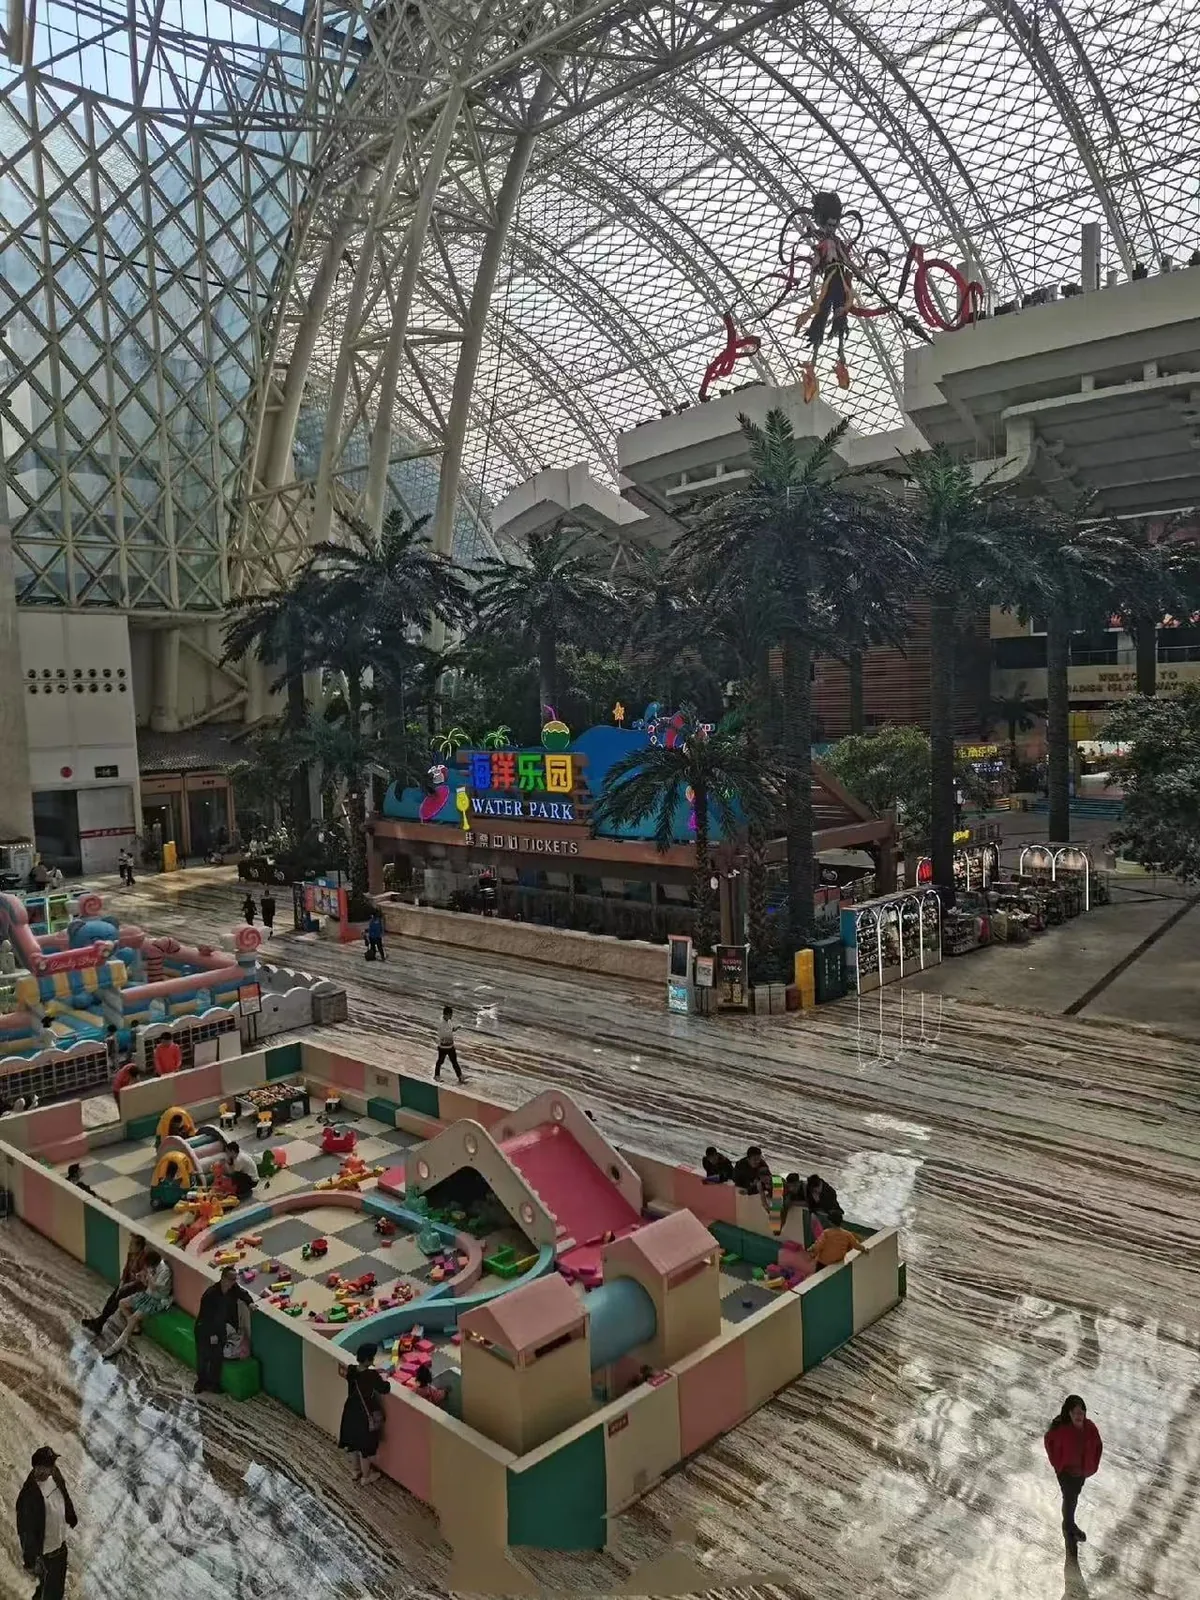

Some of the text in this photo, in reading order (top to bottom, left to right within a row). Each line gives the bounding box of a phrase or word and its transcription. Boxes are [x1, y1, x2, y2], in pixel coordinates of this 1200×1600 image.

[469, 751, 573, 793] 海洋乐园
[471, 797, 574, 821] WATER PARK
[523, 837, 579, 855] TICKETS
